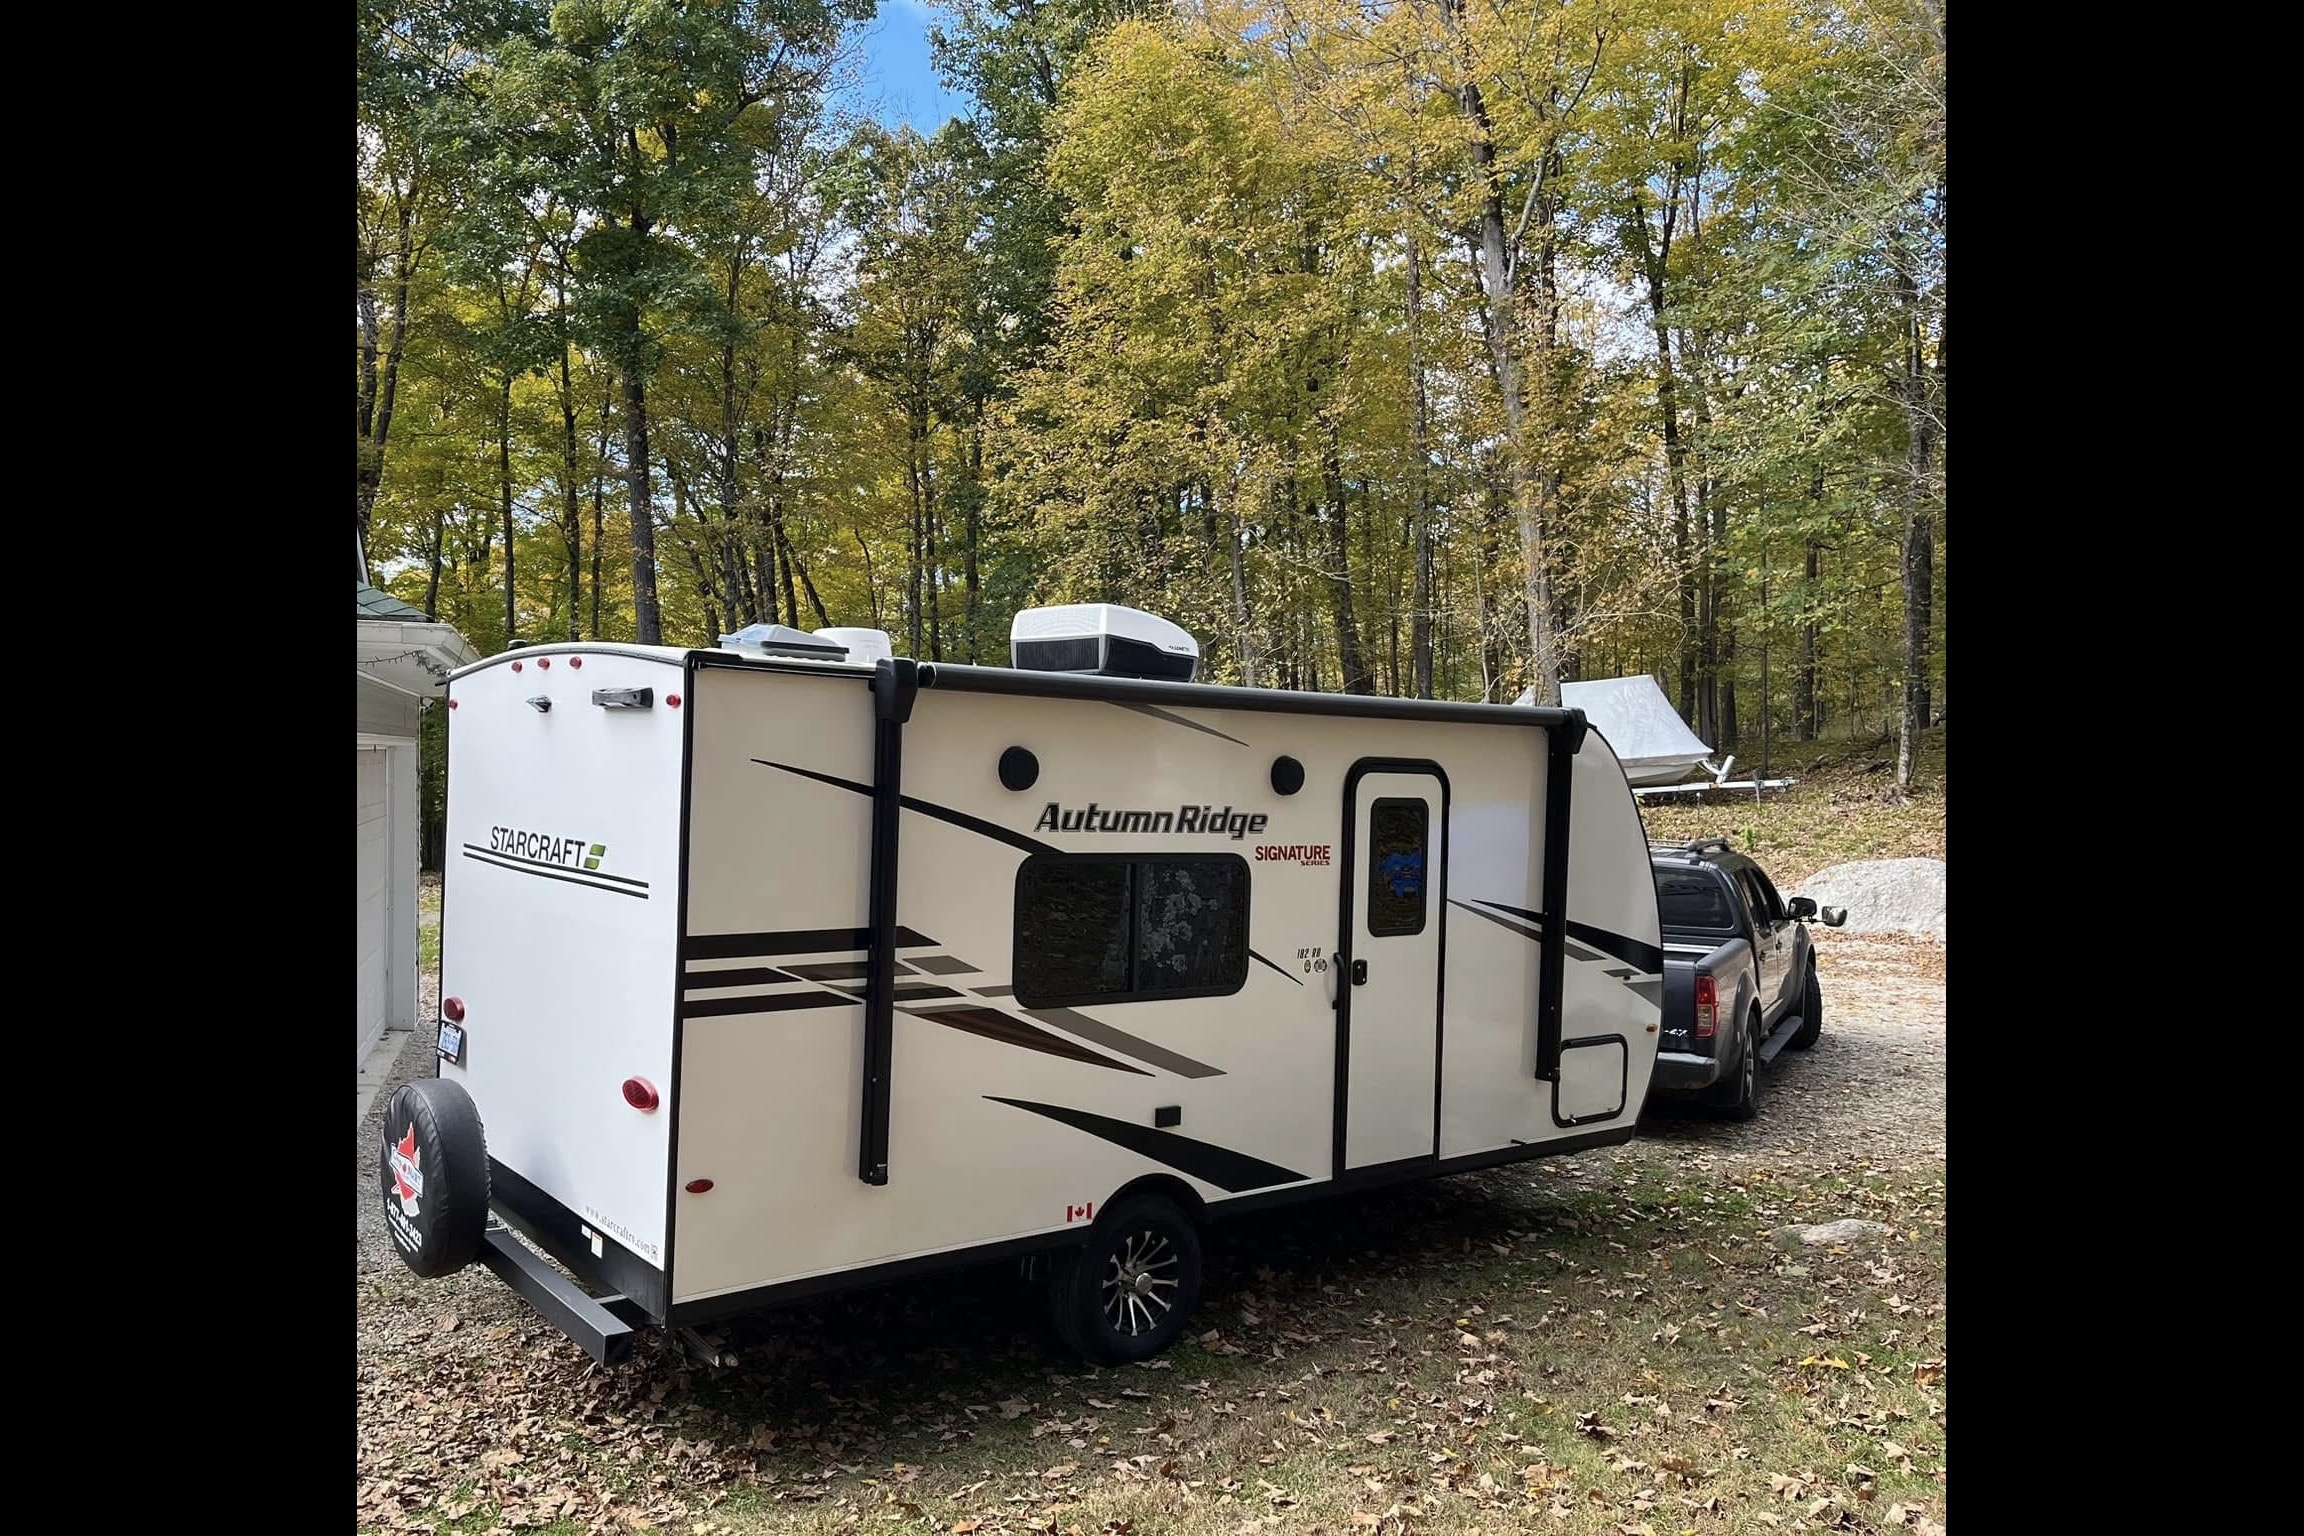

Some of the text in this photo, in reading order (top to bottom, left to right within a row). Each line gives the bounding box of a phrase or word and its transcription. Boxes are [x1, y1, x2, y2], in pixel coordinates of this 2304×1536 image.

[1034, 802, 1268, 840] Autumn Ridge
[490, 826, 586, 867] STARCRAFT
[1255, 845, 1331, 861] SIGNATURE
